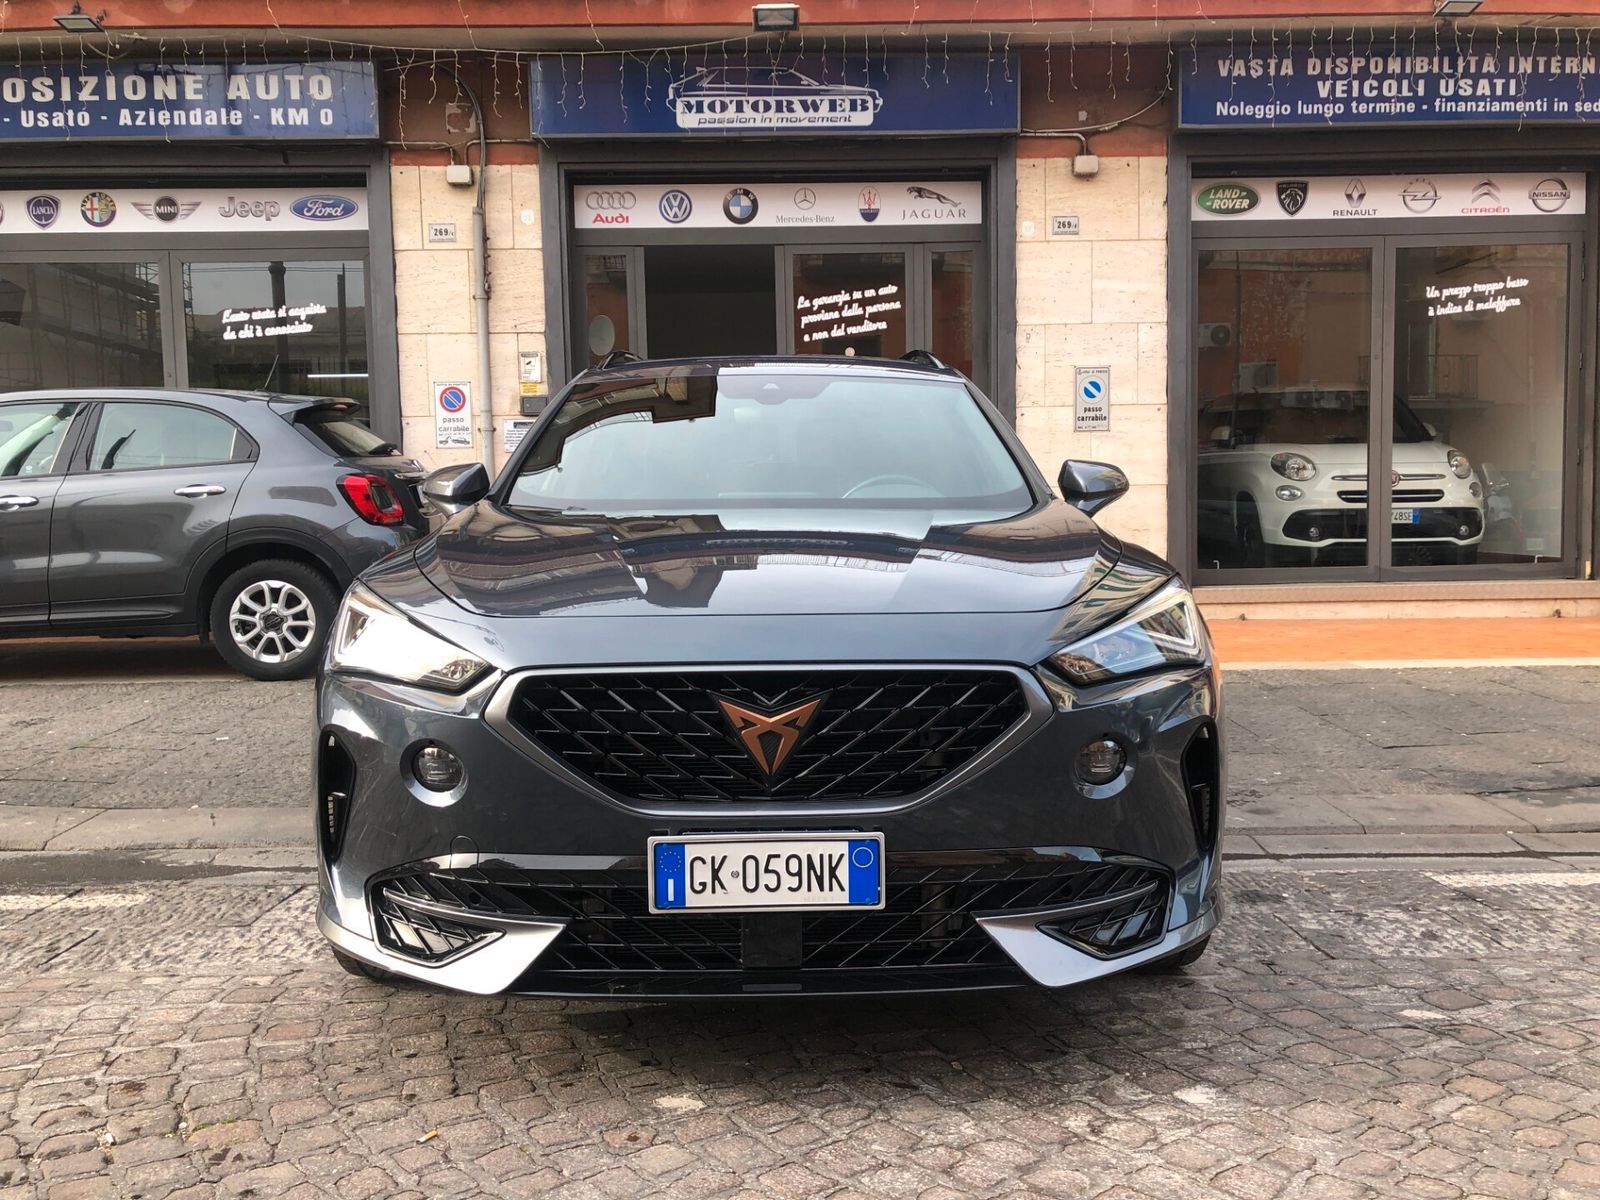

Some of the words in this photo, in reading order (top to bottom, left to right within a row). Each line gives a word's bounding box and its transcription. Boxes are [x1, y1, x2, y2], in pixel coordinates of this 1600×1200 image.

[1217, 58, 1294, 77] VASTA
[1306, 53, 1496, 76] DISPONIBILITÀ
[1508, 56, 1600, 75] INTERN
[2, 74, 204, 103] OSIZIONE
[226, 74, 333, 101] AUTO
[1317, 79, 1425, 98] VEICOLI
[1439, 78, 1517, 97] USATI
[681, 98, 870, 114] MOTORWEB
[1216, 101, 1291, 118] Noleggio
[1297, 100, 1345, 117] lungo
[1351, 98, 1416, 114] termine
[1434, 97, 1547, 113] finanziamenti
[1554, 97, 1569, 113] in
[20, 108, 91, 128] Usato
[118, 107, 243, 126] Aziendale
[270, 107, 309, 126] KM
[697, 115, 756, 126] passion
[760, 115, 772, 124] in
[776, 114, 852, 124] movement
[1209, 188, 1240, 199] LAND
[32, 206, 54, 215] LANCIA
[155, 205, 178, 214] MINI
[218, 196, 280, 221] Jeep
[303, 199, 345, 217] Ford
[1212, 199, 1250, 209] ROVER
[1332, 208, 1378, 217] RENAULT
[592, 213, 630, 224] Audi
[775, 214, 836, 224] Mercedes-Benz
[902, 208, 967, 221] JAGUAR
[1426, 285, 1440, 298] Un
[1441, 285, 1473, 301] prezzo
[1473, 281, 1505, 296] troppo
[1506, 275, 1530, 288] basso
[796, 295, 811, 310] La
[812, 290, 852, 311] garanzia
[852, 290, 863, 300] su
[864, 288, 876, 298] un
[878, 284, 898, 296] auto
[1436, 302, 1462, 316] indice
[1464, 299, 1474, 313] di
[1475, 294, 1521, 313] malaffare
[251, 308, 277, 320] usata
[277, 304, 287, 318] si
[288, 302, 327, 320] acquista
[800, 309, 840, 329] proviene
[841, 302, 864, 317] dalla
[865, 300, 901, 319] persona
[223, 325, 237, 340] da
[238, 323, 254, 339] chi
[264, 320, 313, 336] conosciuto
[812, 330, 829, 341] non
[830, 323, 845, 338] dal
[846, 319, 888, 335] venditore
[1077, 413, 1107, 421] carrabile
